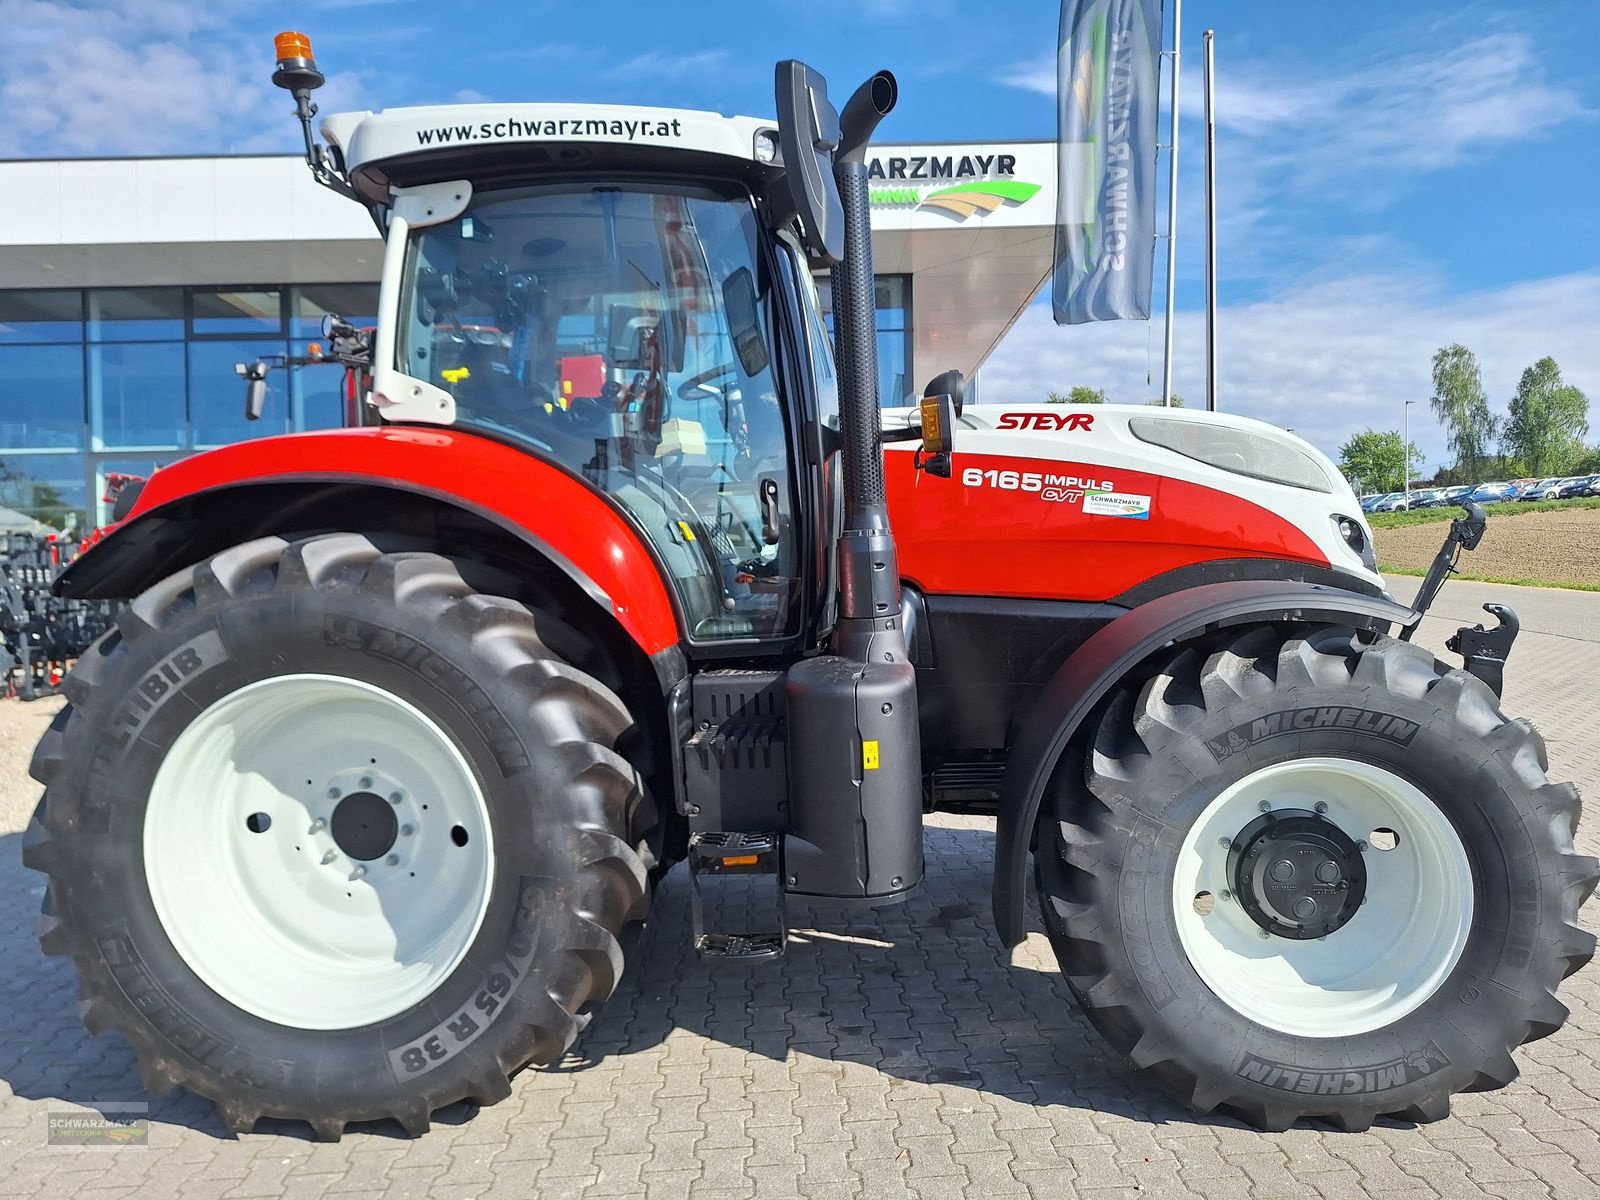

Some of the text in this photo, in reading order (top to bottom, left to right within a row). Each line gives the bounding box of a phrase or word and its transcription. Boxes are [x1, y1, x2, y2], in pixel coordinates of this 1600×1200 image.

[416, 118, 681, 145] www.schwarzmayr.at
[868, 154, 1016, 180] ARZMAYR
[996, 413, 1095, 431] STEYR
[962, 467, 1114, 492] 6165 IMPULS
[1041, 487, 1082, 504] CVT
[1091, 495, 1141, 506] SCHWARZMAYR
[1251, 707, 1419, 742] MICHELIN
[446, 1012, 480, 1043] R
[401, 1034, 449, 1074] 38
[1238, 1060, 1408, 1095] MICHELIN
